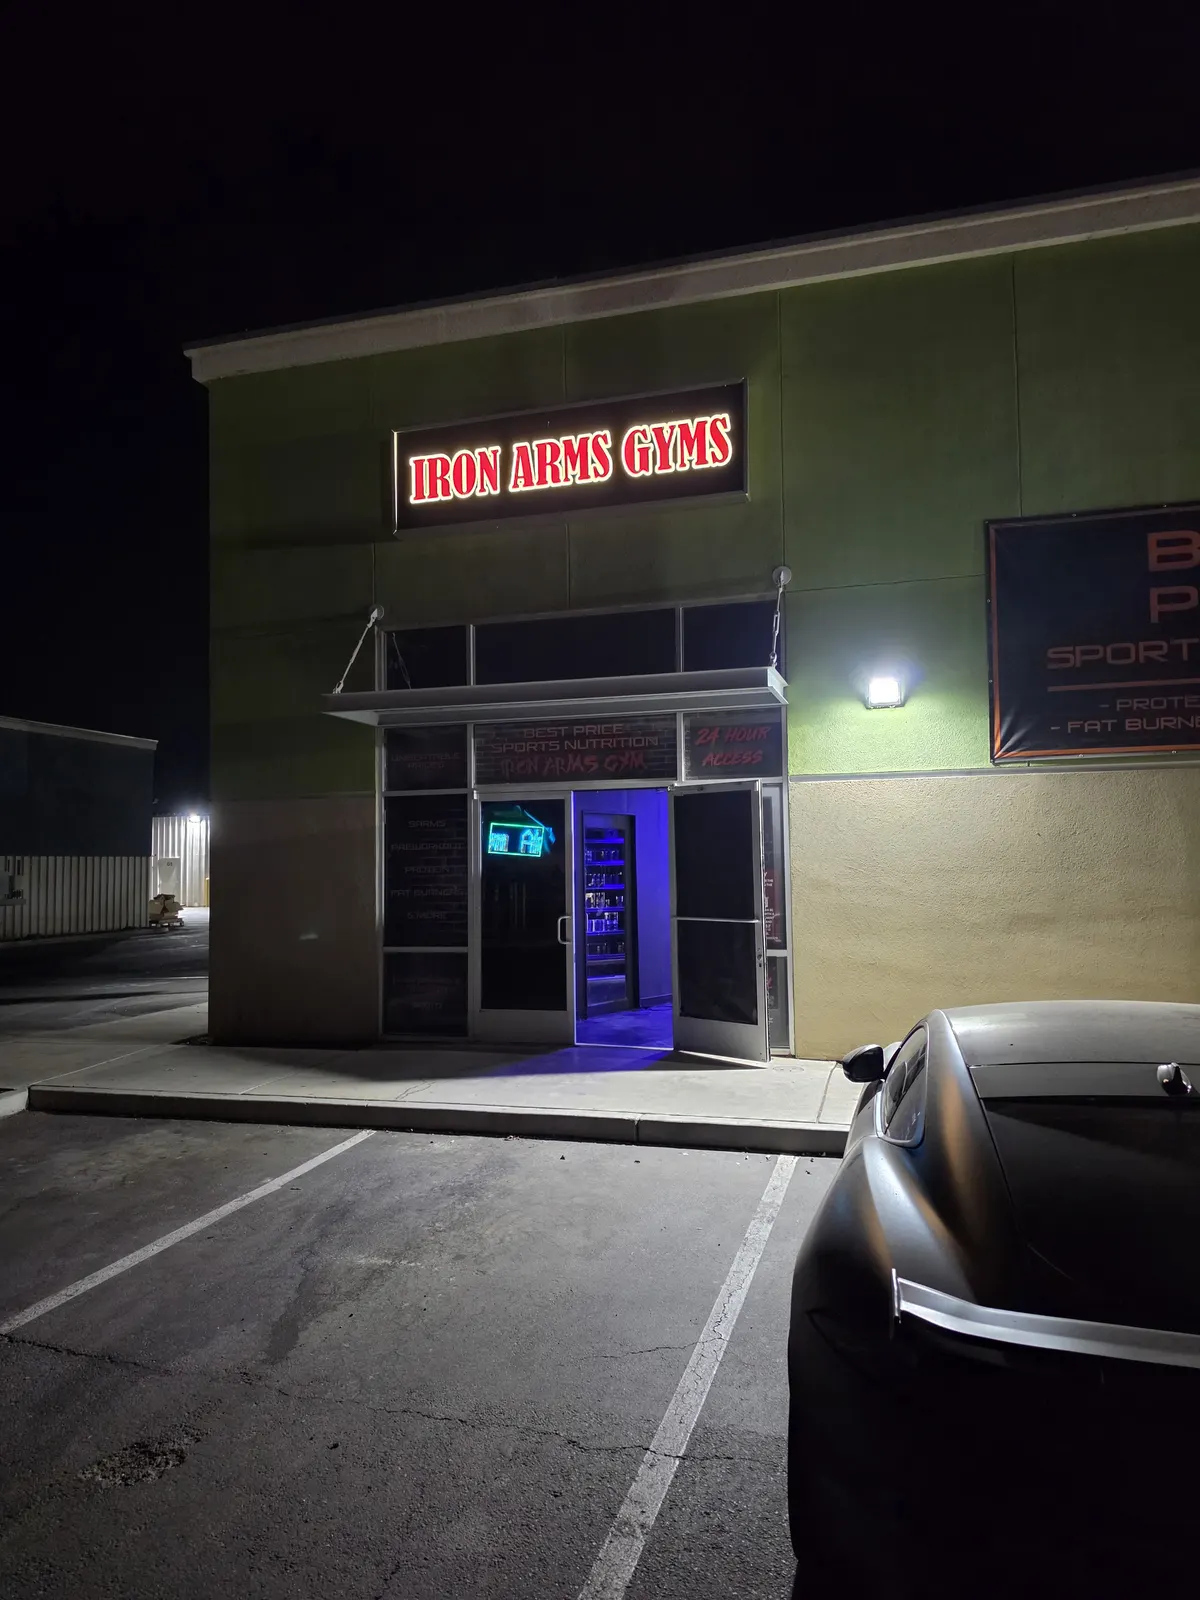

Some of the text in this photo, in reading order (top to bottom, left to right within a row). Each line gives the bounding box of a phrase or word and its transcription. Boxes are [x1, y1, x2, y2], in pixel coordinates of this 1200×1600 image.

[409, 413, 733, 504] IRON ARMS GYMS
[1047, 638, 1200, 669] SPORT
[524, 724, 623, 738] BEST PRICE
[1067, 719, 1118, 733] FAT
[492, 736, 659, 753] SPORTS NUTRITION
[694, 726, 771, 747] 24 HOUR
[501, 750, 647, 778] IRON ARMS GYM
[702, 750, 763, 767] ACCESS
[408, 820, 446, 828] SARMS
